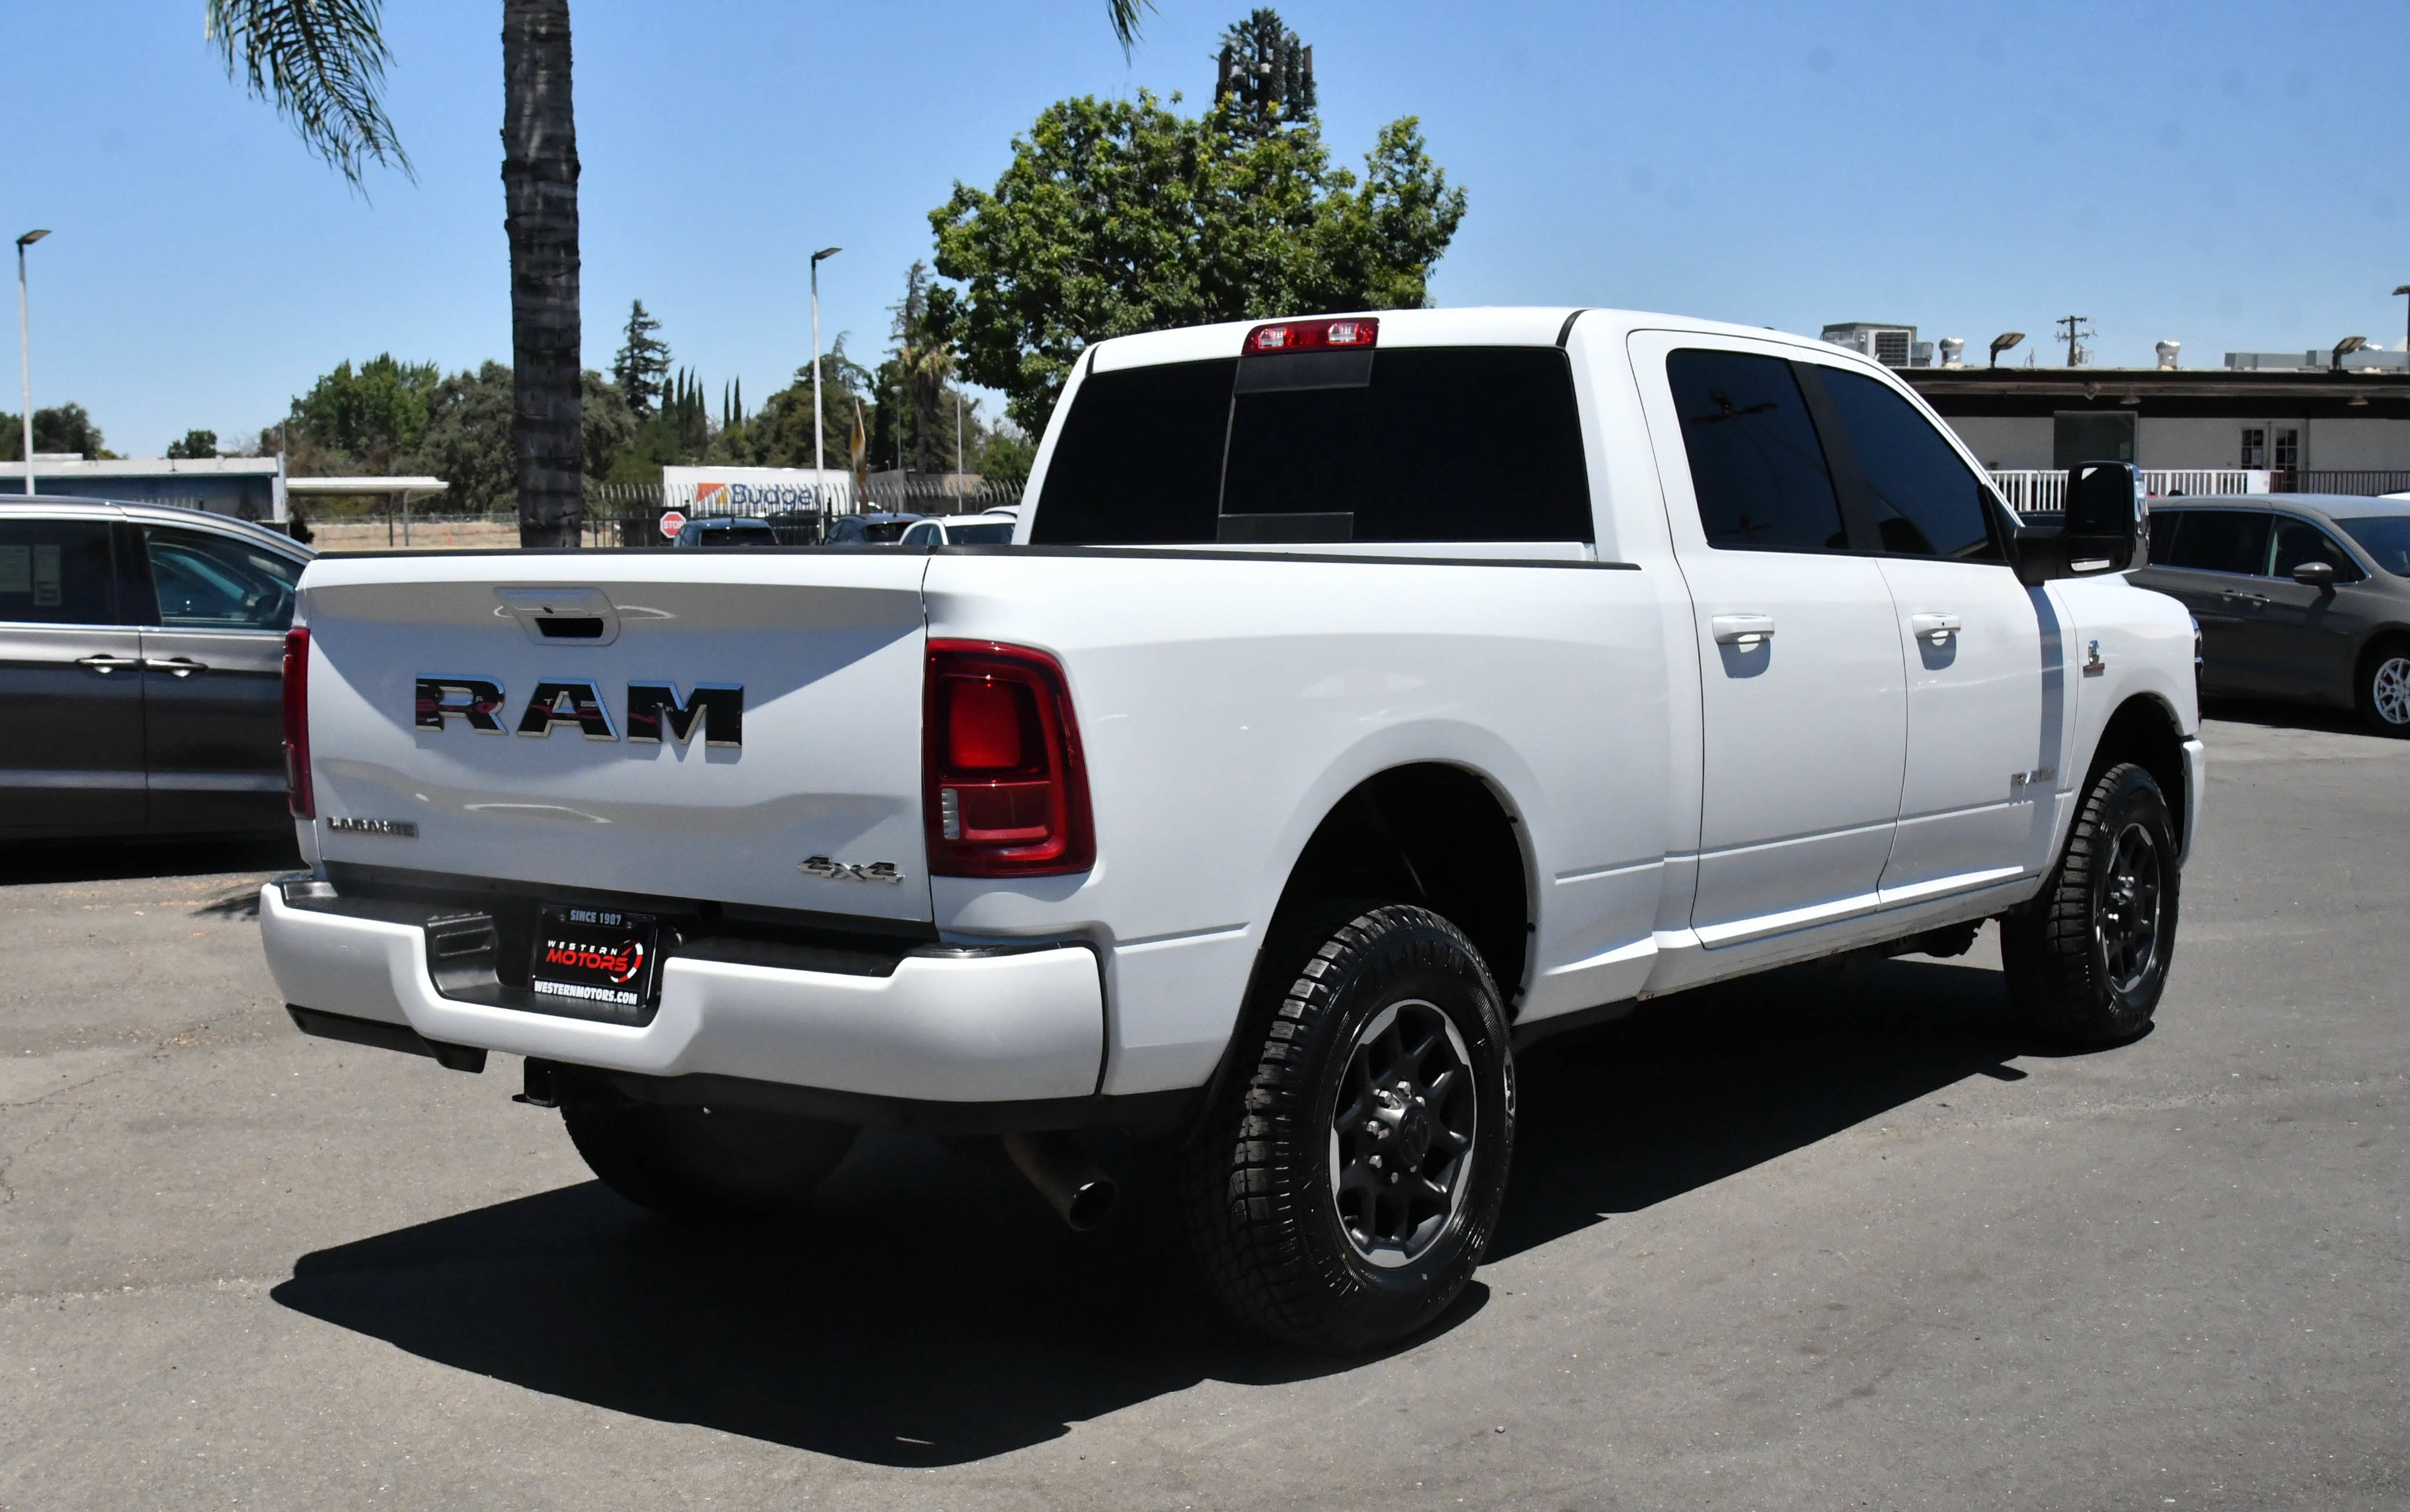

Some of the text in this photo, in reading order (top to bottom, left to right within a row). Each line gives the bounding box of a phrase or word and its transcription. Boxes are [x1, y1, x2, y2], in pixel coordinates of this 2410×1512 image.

[663, 520, 683, 530] STOP
[415, 673, 744, 748] RAM
[570, 909, 597, 923] SINCE
[548, 940, 618, 956] WESTERN
[546, 948, 628, 972] MOTORS
[534, 980, 638, 1005] WESTERNMOTORS.COM
